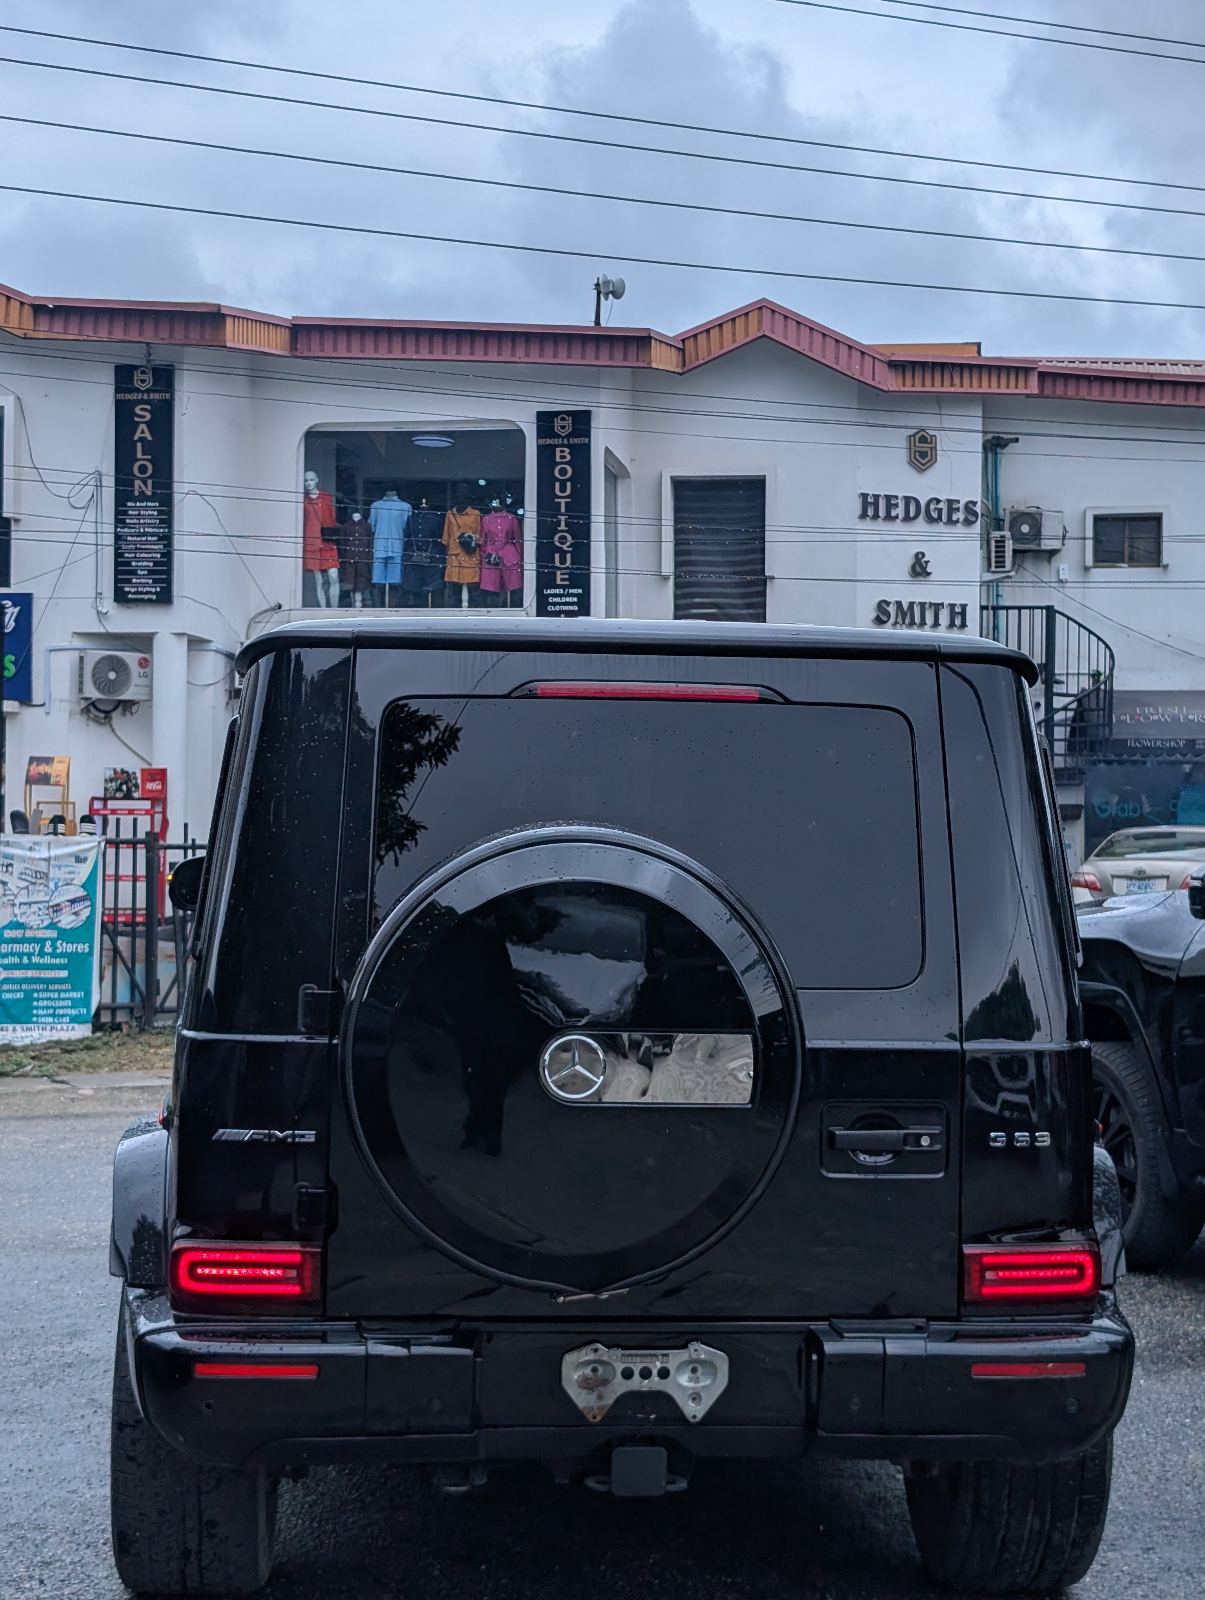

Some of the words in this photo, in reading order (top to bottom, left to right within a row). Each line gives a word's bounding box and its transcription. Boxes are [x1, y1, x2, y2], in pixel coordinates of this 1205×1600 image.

[133, 404, 153, 496] SALON
[554, 447, 573, 585] BOUTIQUE
[858, 492, 979, 526] HEDGES
[908, 551, 933, 577] &
[872, 599, 969, 629] SMITH
[138, 671, 149, 679] LG
[1, 943, 40, 955] armacy
[44, 940, 53, 953] &
[56, 940, 90, 953] Stores
[242, 1129, 316, 1143] AMG
